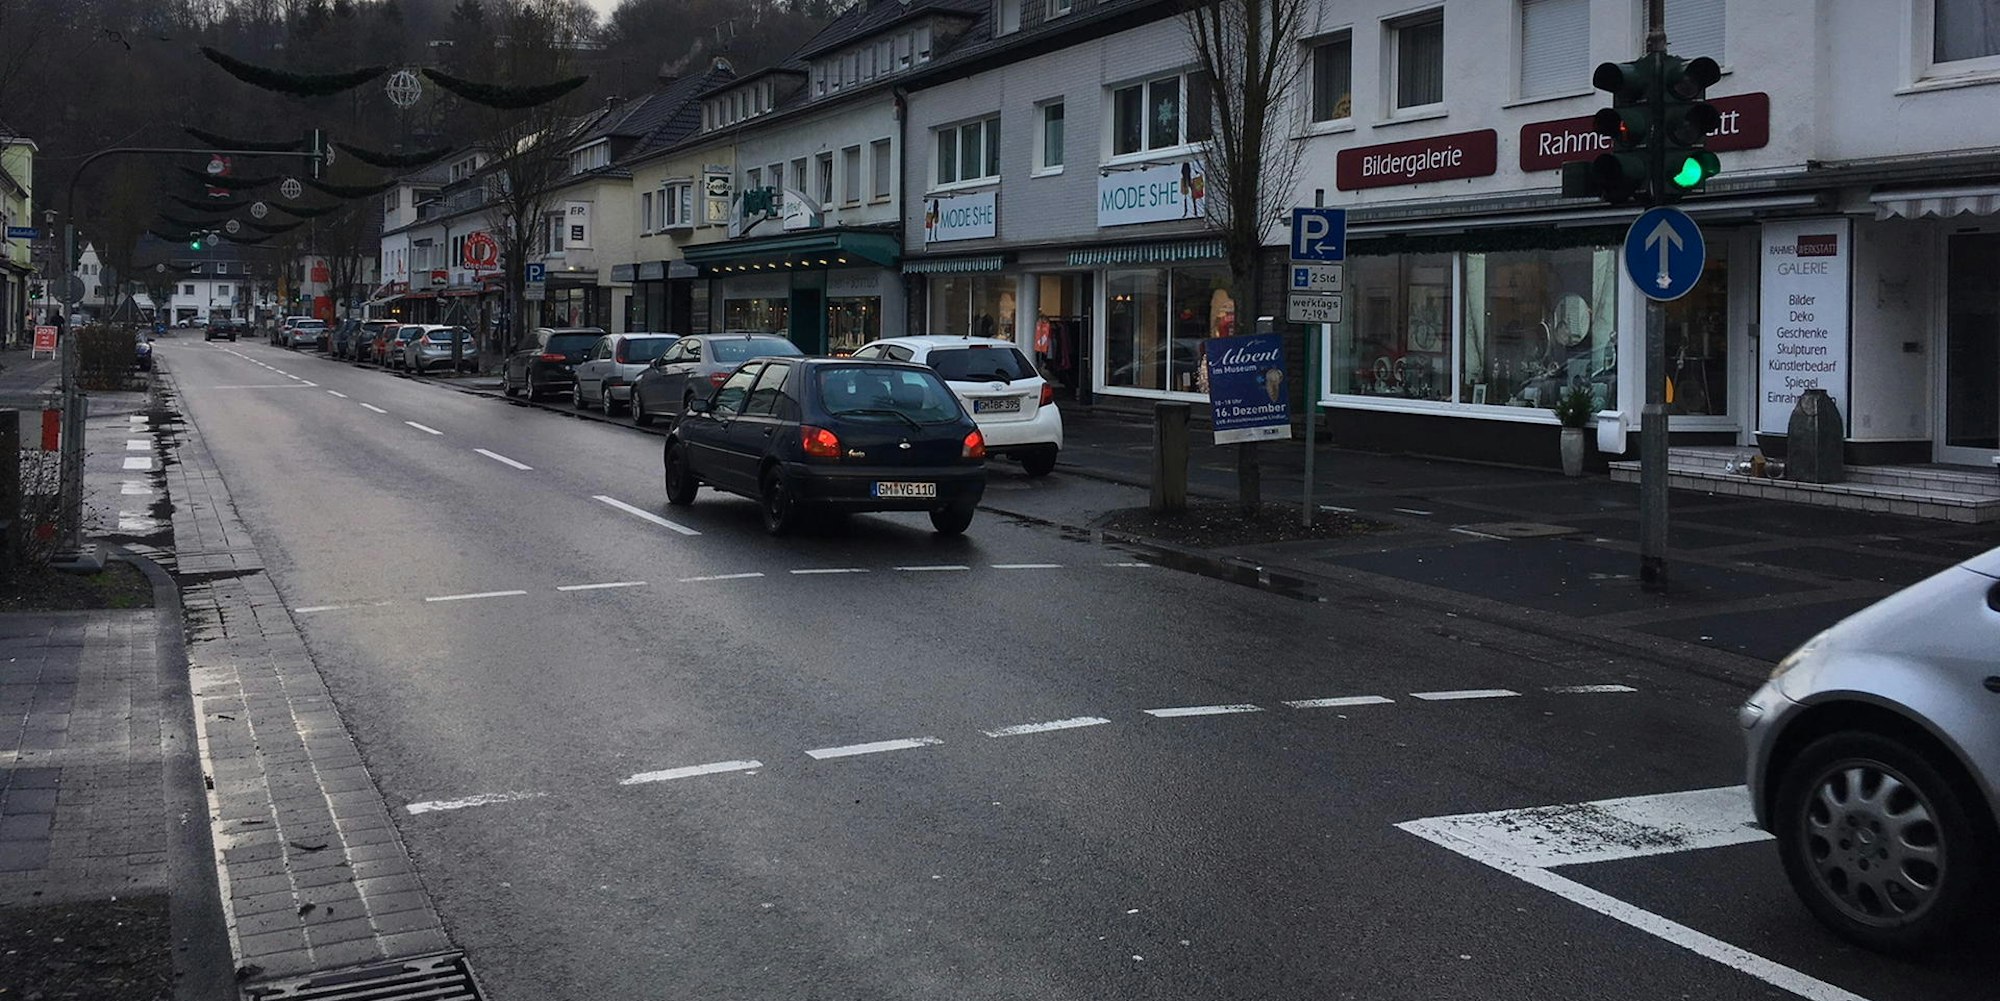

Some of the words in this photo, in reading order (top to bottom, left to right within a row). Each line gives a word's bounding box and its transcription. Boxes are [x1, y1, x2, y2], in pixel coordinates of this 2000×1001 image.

[1362, 145, 1463, 178] Bildergalerie
[1101, 184, 1146, 211] MODE
[1149, 181, 1179, 207] SHE
[940, 209, 971, 229] MODE
[972, 204, 993, 226] SHE
[1300, 214, 1329, 254] P
[529, 265, 541, 281] P
[1777, 261, 1829, 276] GALERIE
[1311, 273, 1318, 283] 2
[1292, 299, 1339, 310] werktags
[1789, 294, 1816, 306] Bilder
[1789, 310, 1815, 322] Deko
[1776, 327, 1828, 339] Geschenke
[1209, 347, 1280, 366] Advent
[1777, 343, 1827, 357] Skulpturen
[1212, 367, 1223, 375] im
[1223, 365, 1258, 374] Museum
[1768, 359, 1837, 372] Künstlerbedarf
[1784, 375, 1818, 390] Spiegel
[1215, 407, 1231, 418] 16.
[1232, 403, 1287, 416] Dezember
[879, 483, 893, 495] GM
[900, 484, 914, 495] YG
[915, 484, 935, 496] 110
